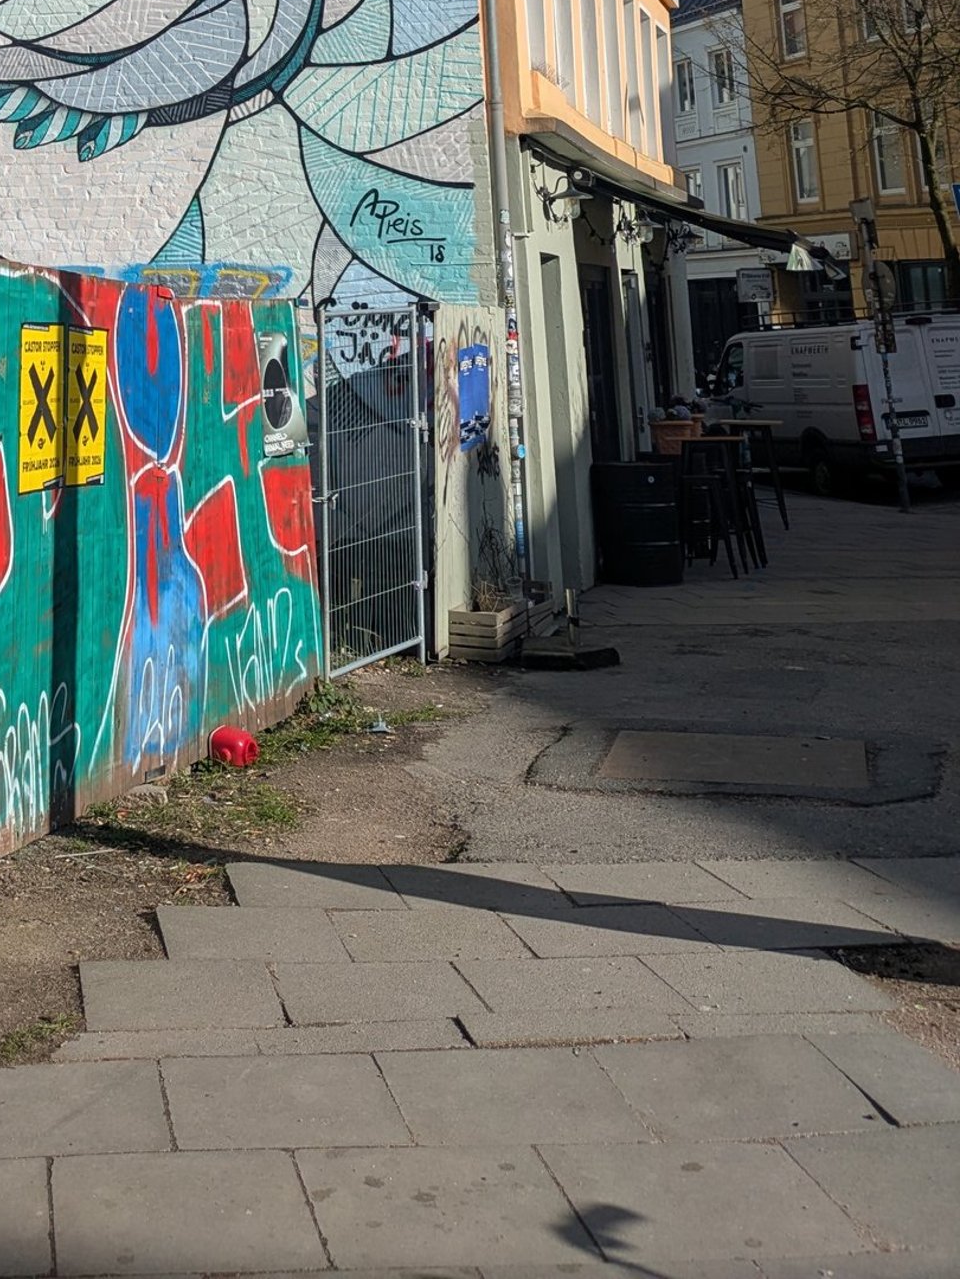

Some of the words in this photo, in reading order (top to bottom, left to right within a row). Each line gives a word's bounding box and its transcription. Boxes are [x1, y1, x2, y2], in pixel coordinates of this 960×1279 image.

[24, 340, 42, 353] CASTOR
[71, 342, 86, 355] CASTOR
[22, 457, 48, 473] FRÜHJAHR
[68, 454, 90, 467] FRÜHJAHR
